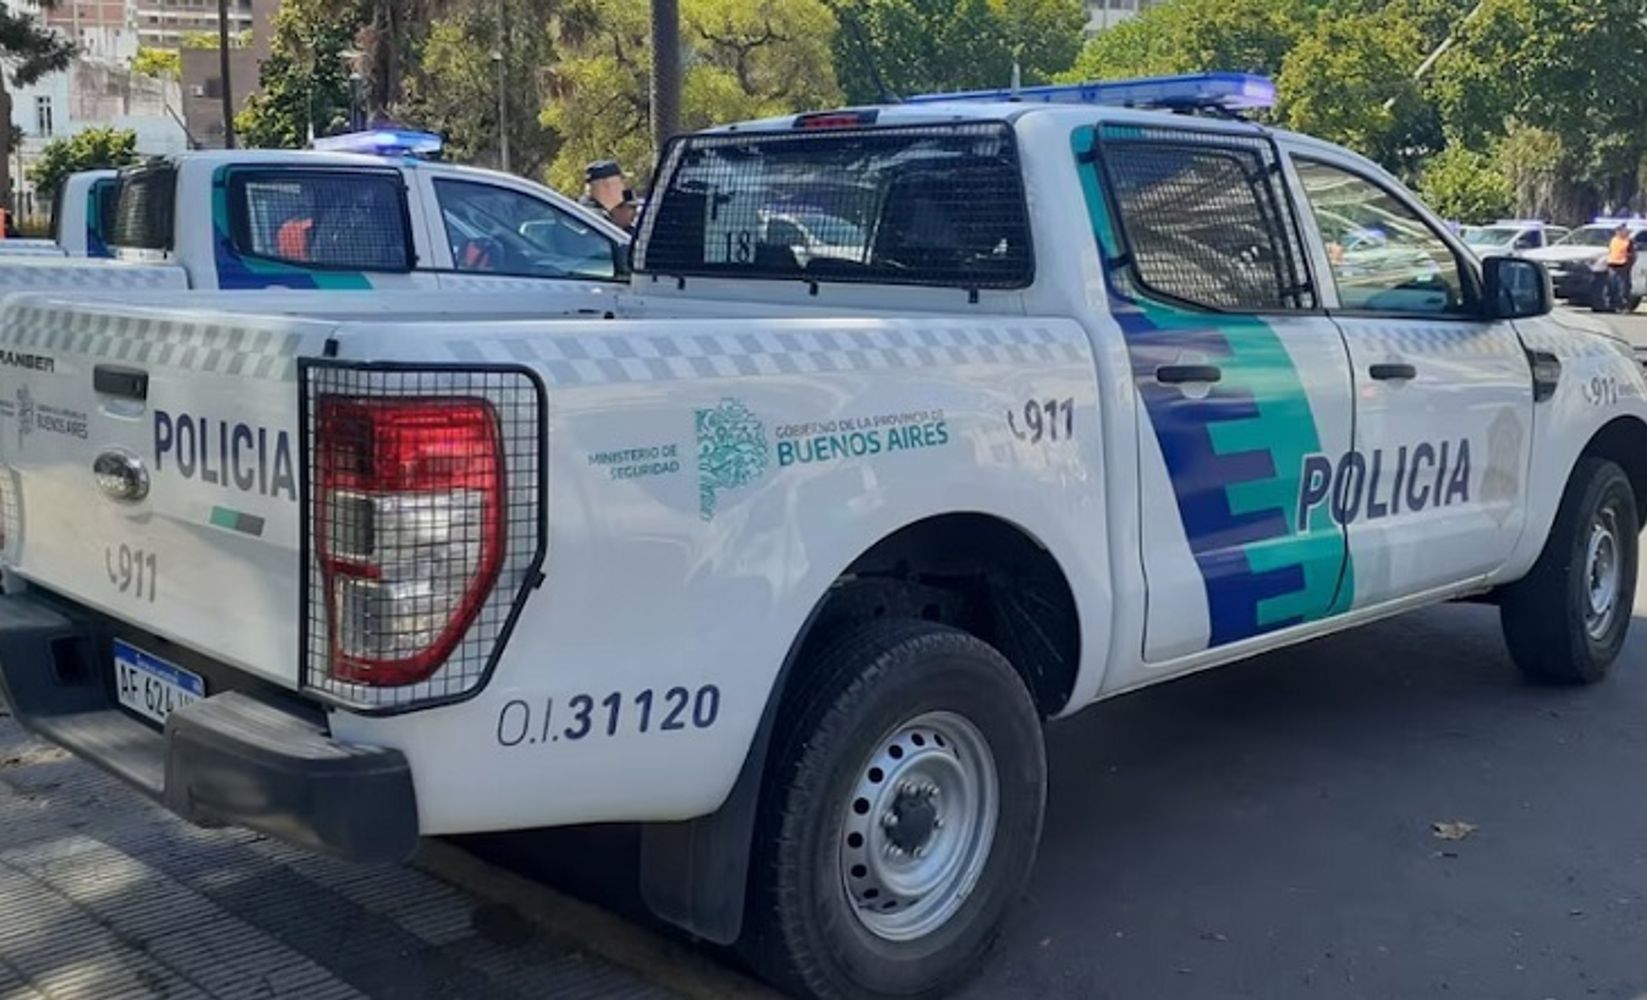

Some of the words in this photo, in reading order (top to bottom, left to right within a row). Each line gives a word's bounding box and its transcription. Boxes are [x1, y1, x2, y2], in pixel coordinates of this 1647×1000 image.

[776, 430, 882, 467] BUENOS
[888, 421, 949, 451] AIRES
[1024, 397, 1074, 445] 911
[154, 409, 297, 501] POLICIA
[588, 447, 660, 466] MINISTERIO
[661, 444, 677, 458] DE
[611, 460, 680, 481] SEGURIDAD
[1299, 438, 1470, 531] POLICIA
[119, 543, 157, 603] 911
